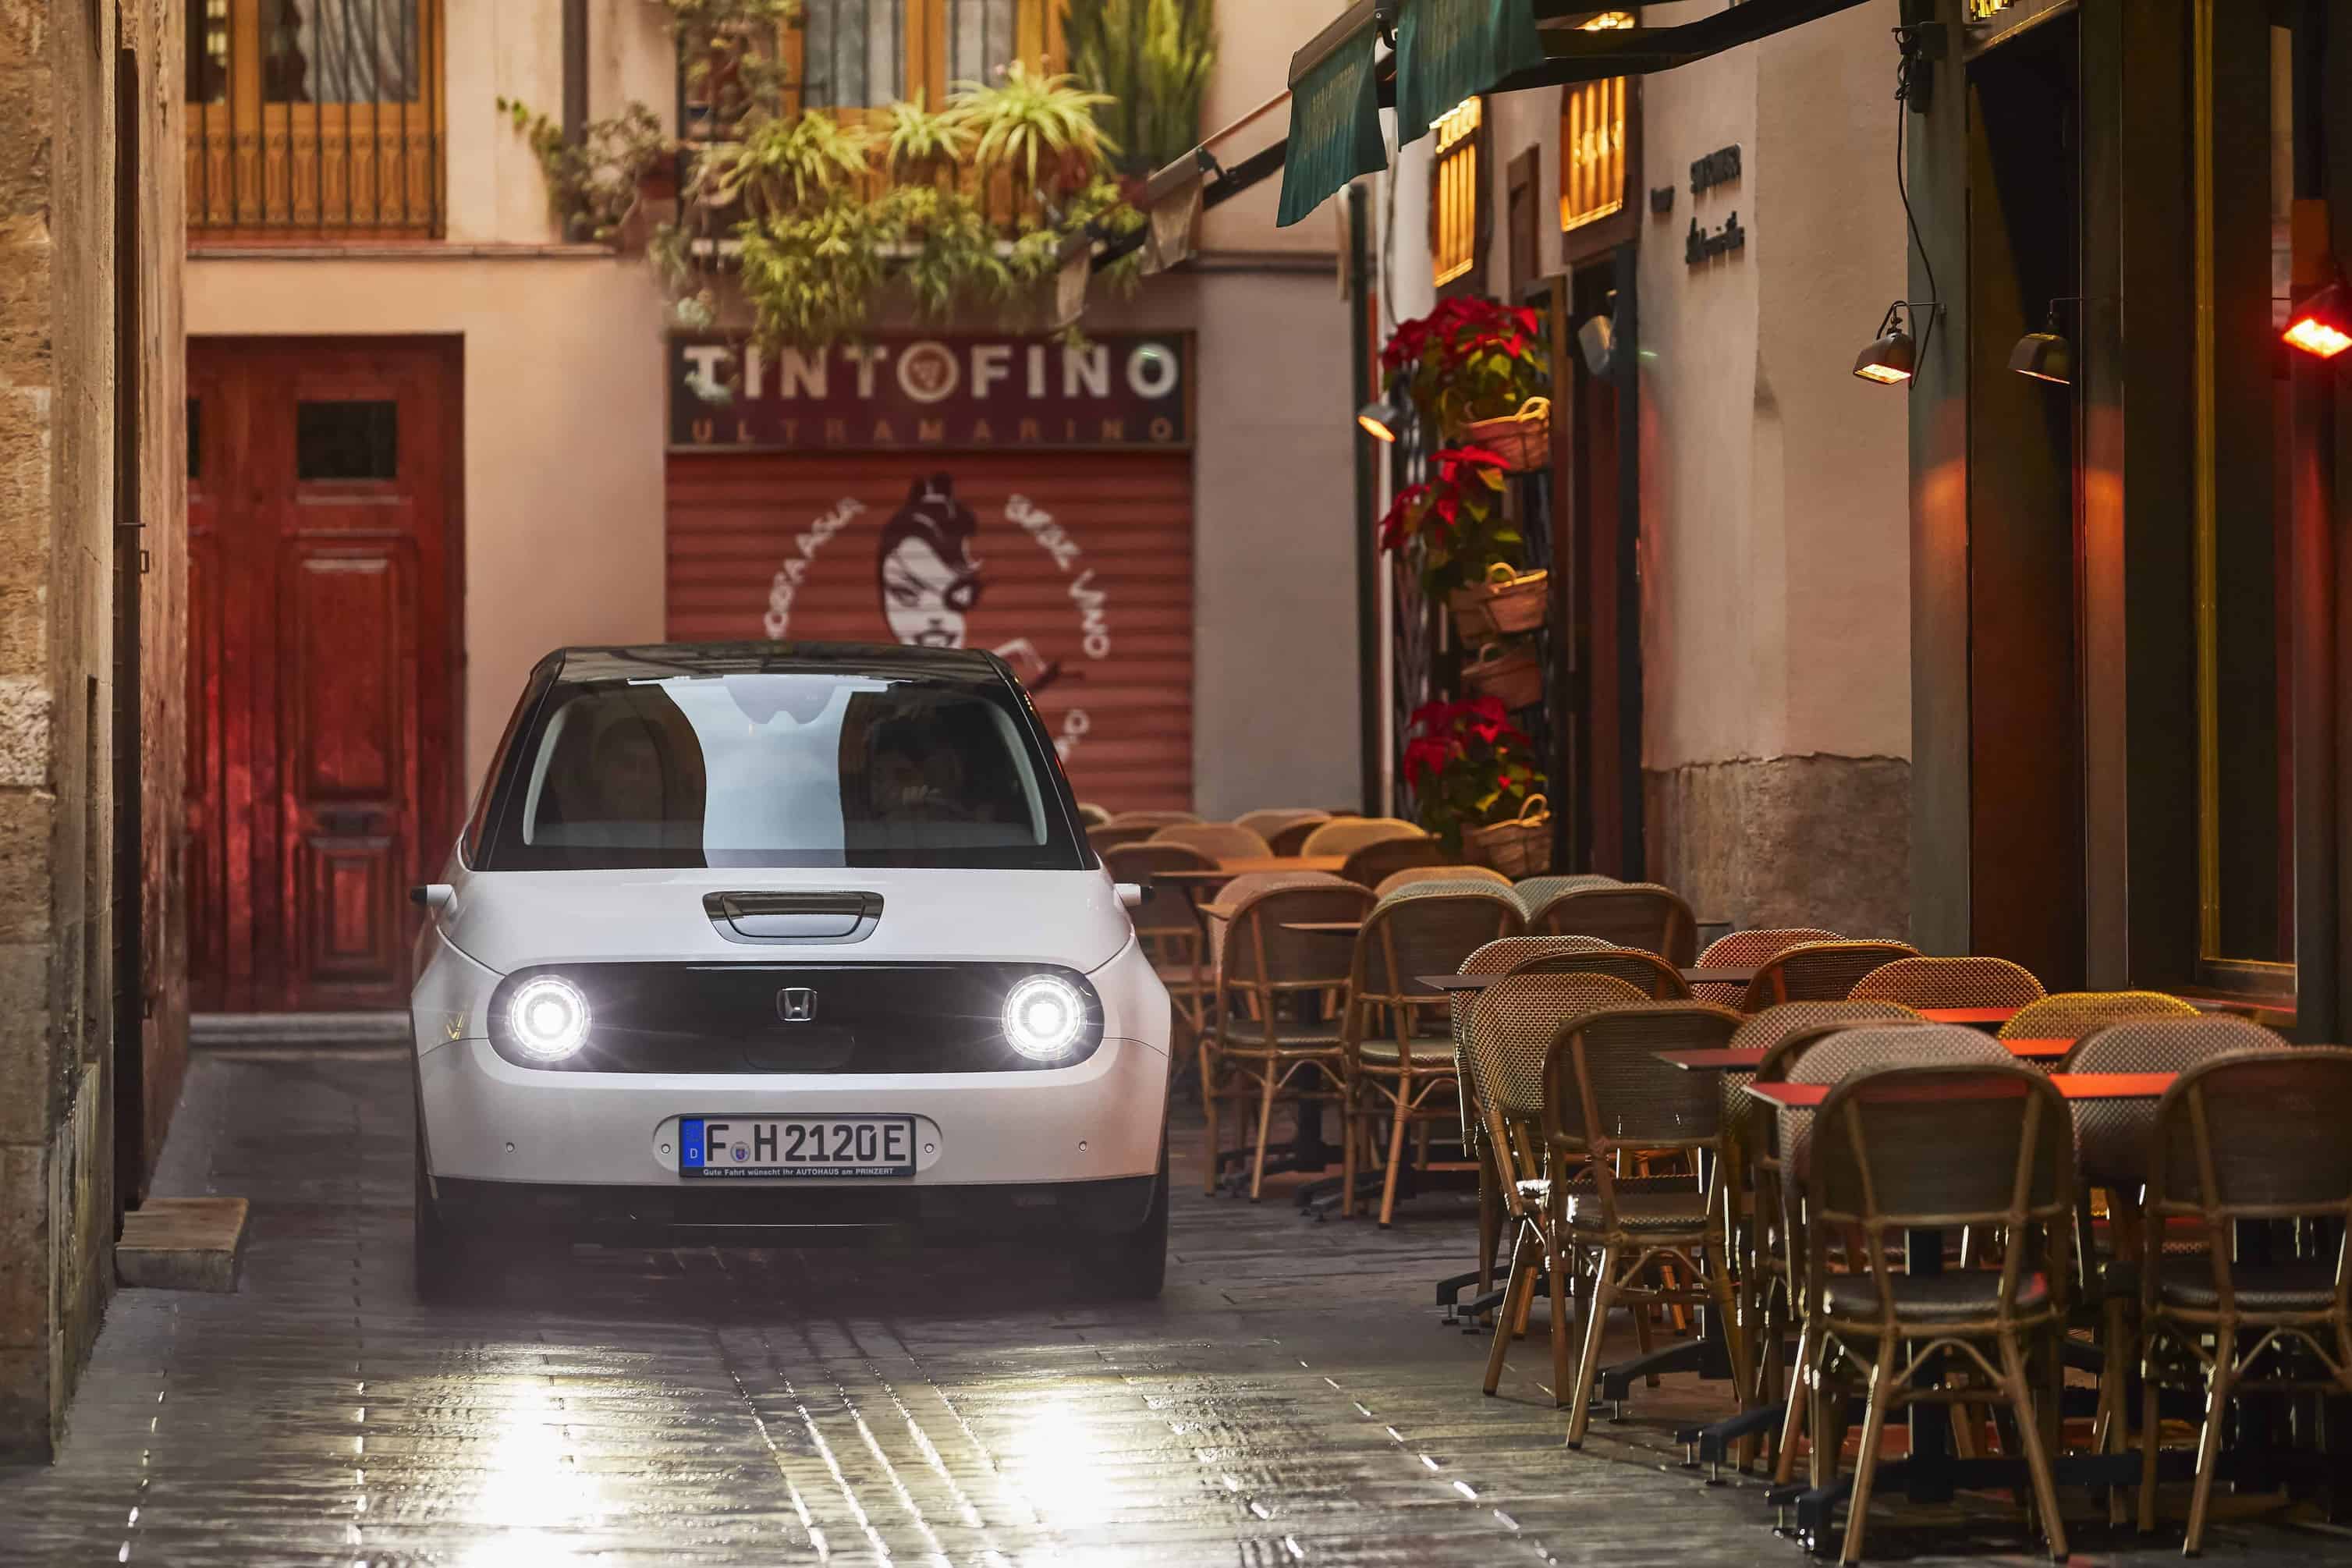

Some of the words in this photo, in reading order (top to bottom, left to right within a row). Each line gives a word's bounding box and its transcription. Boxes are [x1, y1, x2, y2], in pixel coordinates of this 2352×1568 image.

[691, 418, 1174, 442] ULTRAMARINO
[706, 1124, 729, 1162] F
[690, 1148, 699, 1159] D
[703, 1168, 722, 1176] Gute
[724, 1168, 745, 1176] Fahrt
[747, 1168, 781, 1176] wünscht
[796, 1168, 839, 1176] AUTOHAUS
[855, 1167, 894, 1176] PRINZERT
